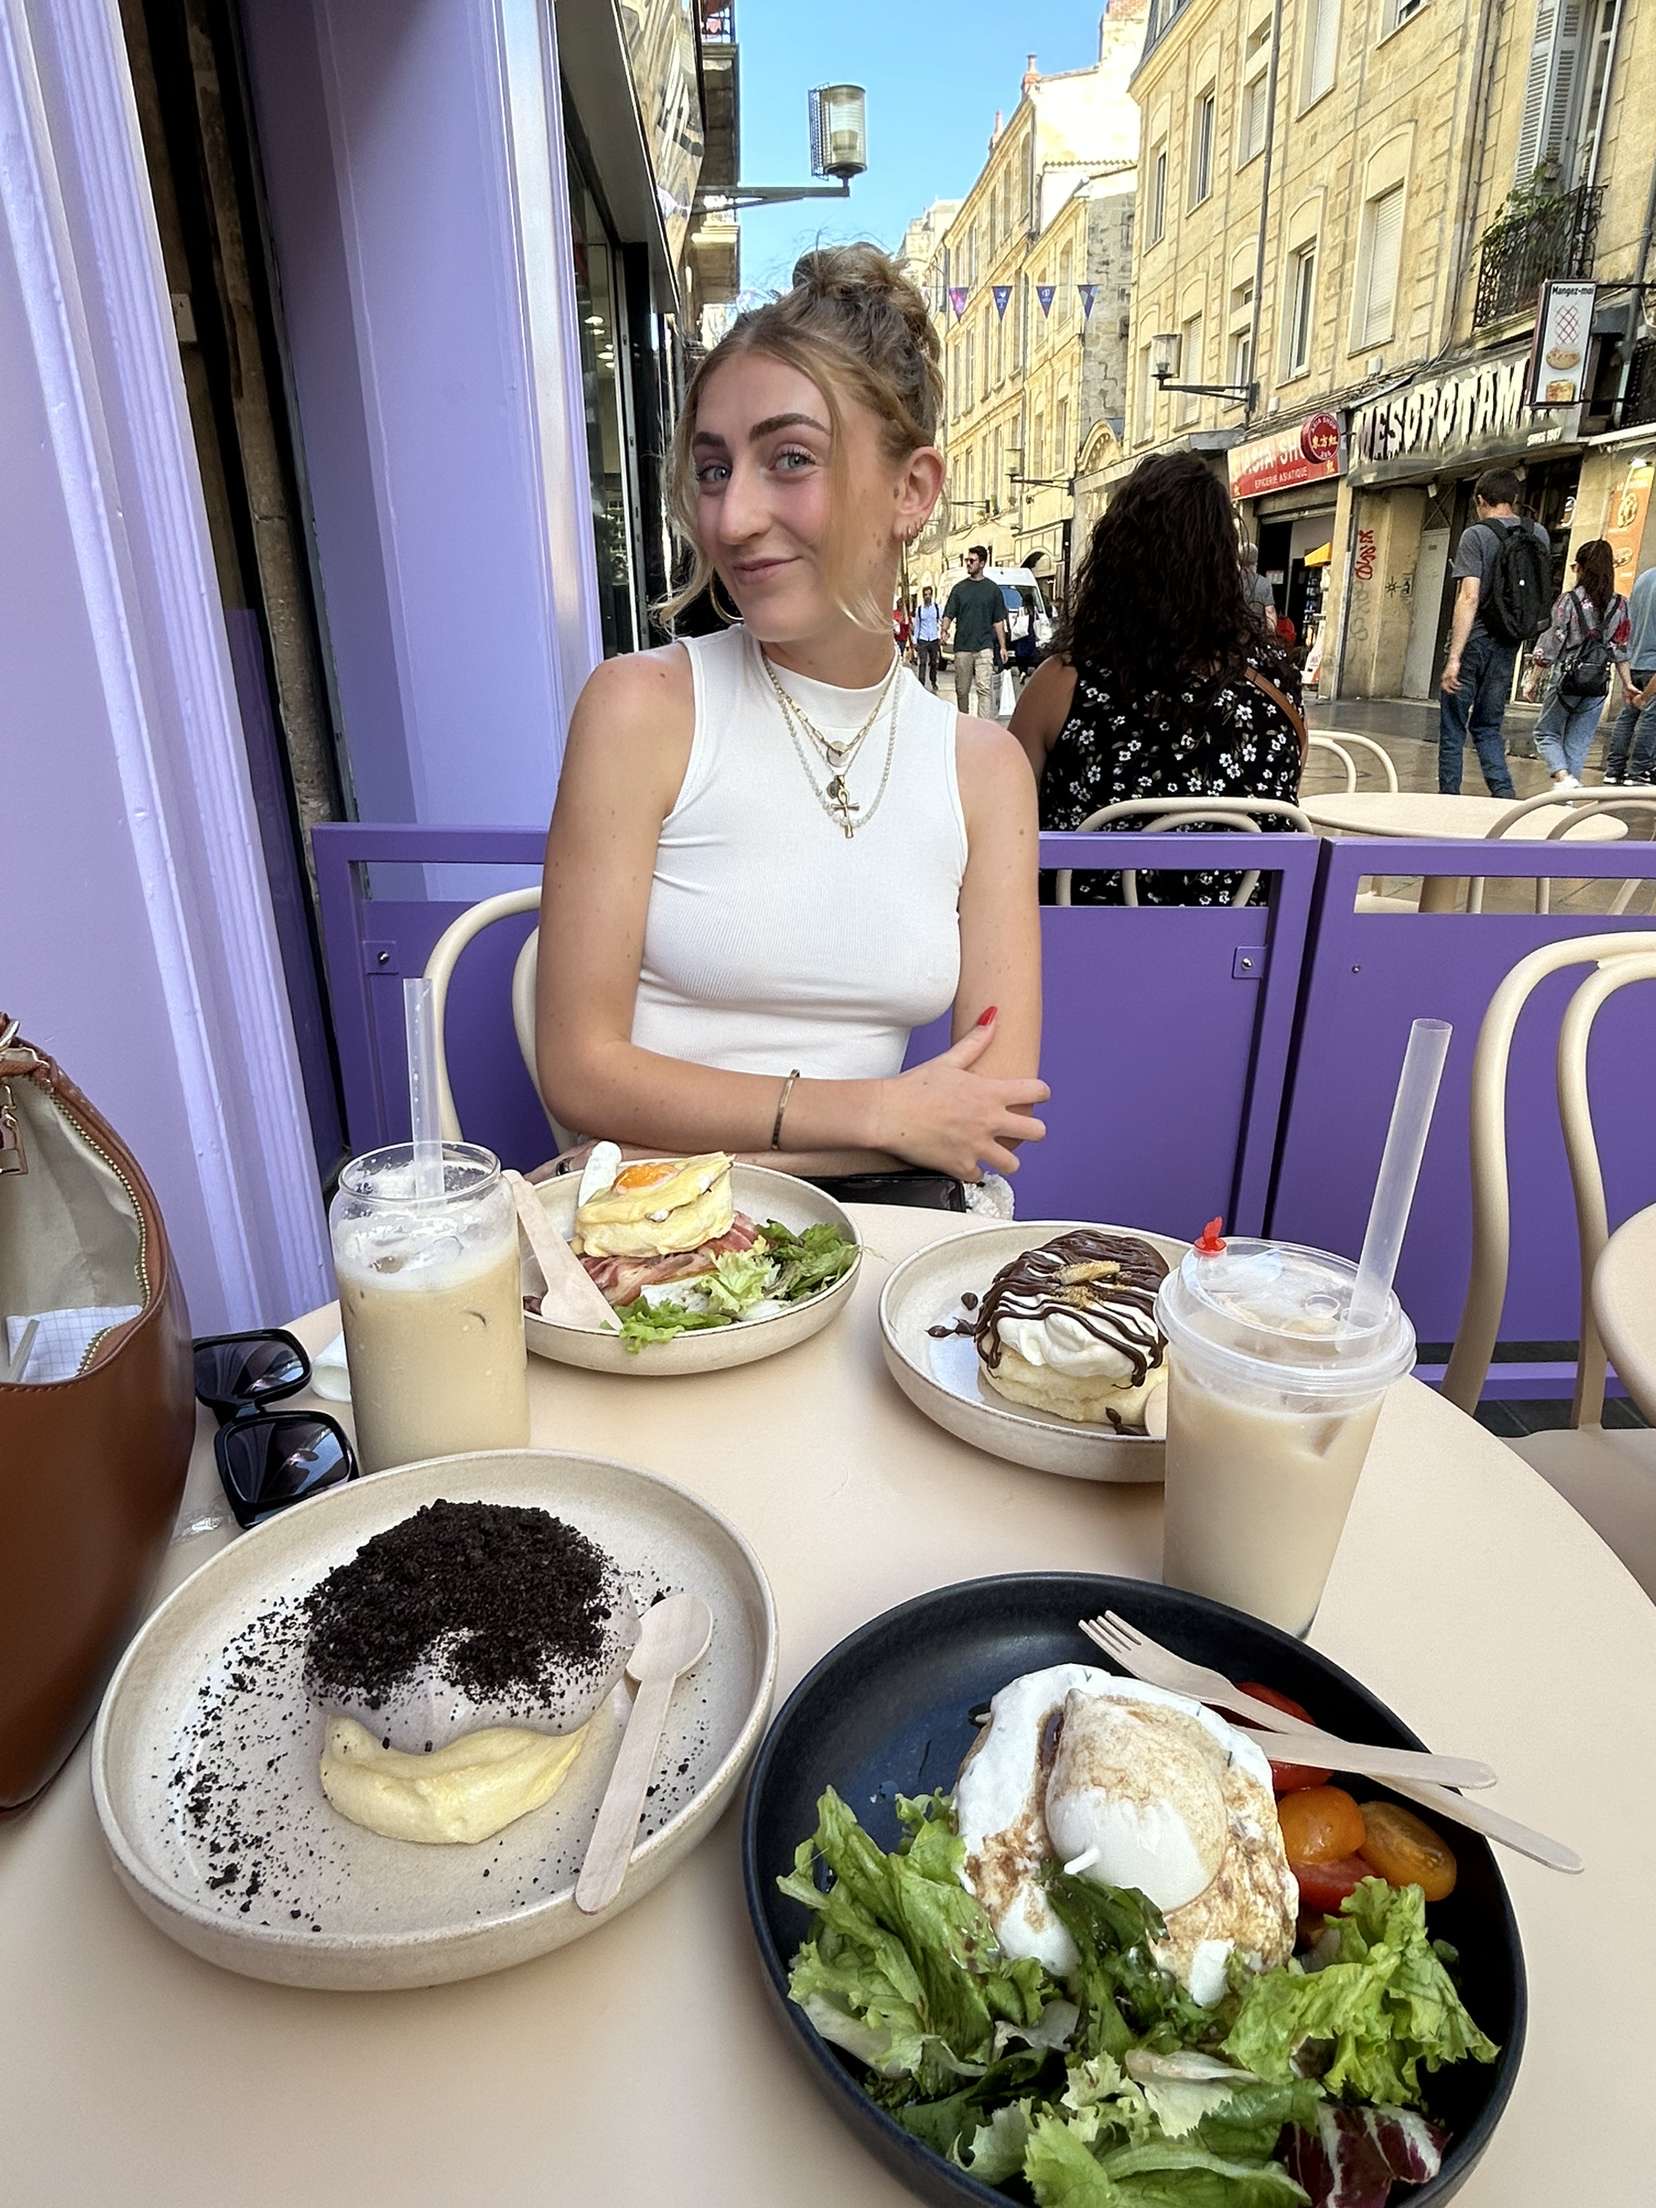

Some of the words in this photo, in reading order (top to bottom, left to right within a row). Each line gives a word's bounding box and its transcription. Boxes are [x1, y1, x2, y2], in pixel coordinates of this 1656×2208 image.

[1552, 286, 1595, 298] Mangez-moi
[1351, 357, 1556, 461] MESOPOTAM
[1254, 474, 1279, 489] EPICERIE
[1279, 466, 1308, 483] ASIATIQUE
